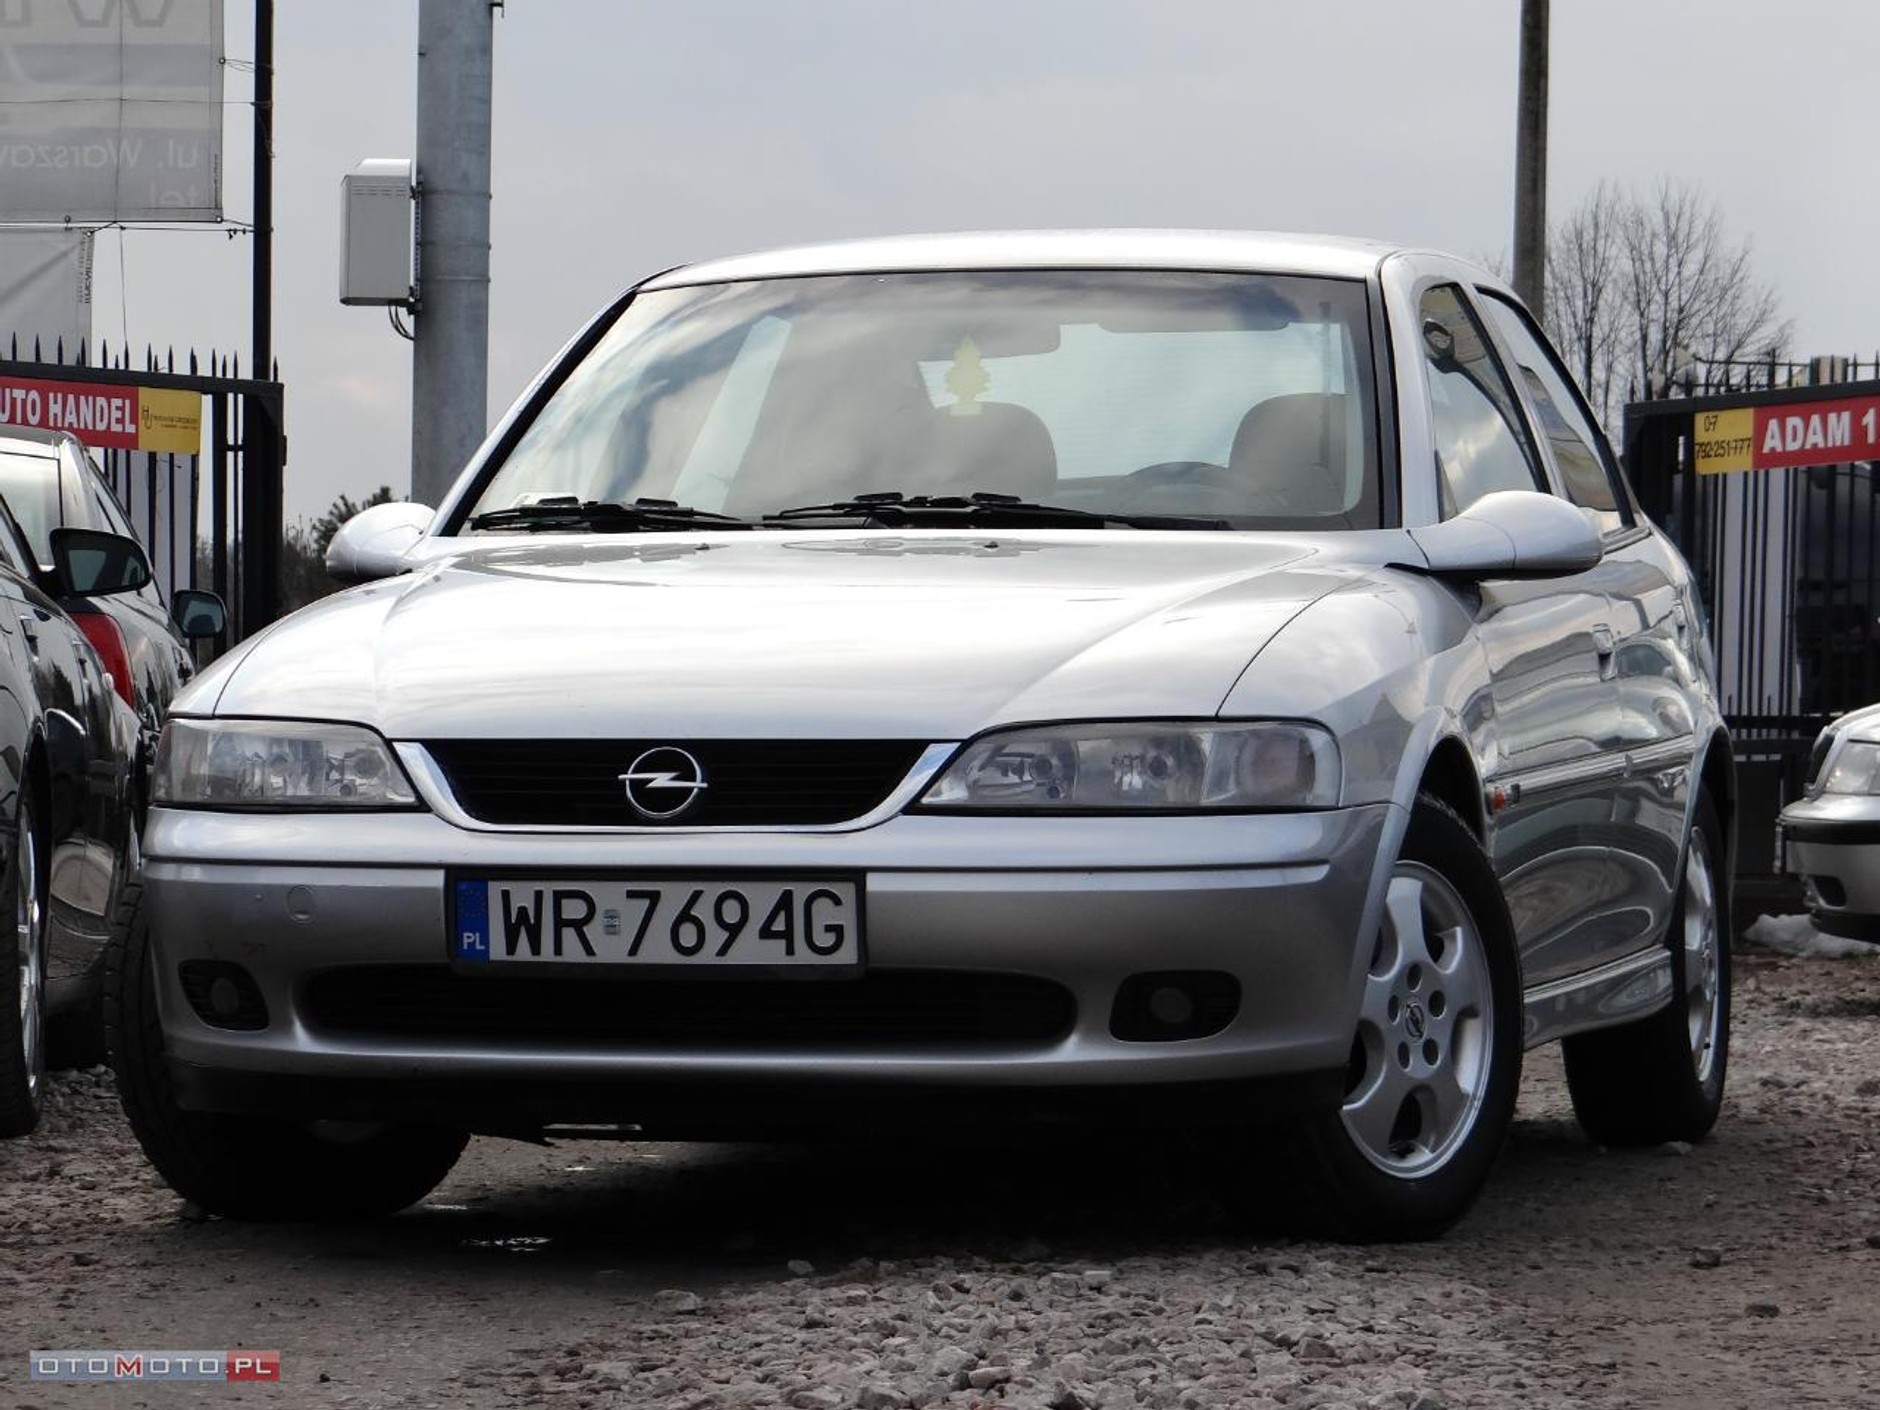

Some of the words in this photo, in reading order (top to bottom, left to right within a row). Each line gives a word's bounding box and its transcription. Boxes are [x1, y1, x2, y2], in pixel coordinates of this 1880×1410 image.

[48, 392, 136, 433] HANDEL
[1762, 411, 1851, 454] ADAM
[462, 932, 486, 950] PL
[501, 889, 597, 957] WR
[625, 888, 845, 957] 7694G
